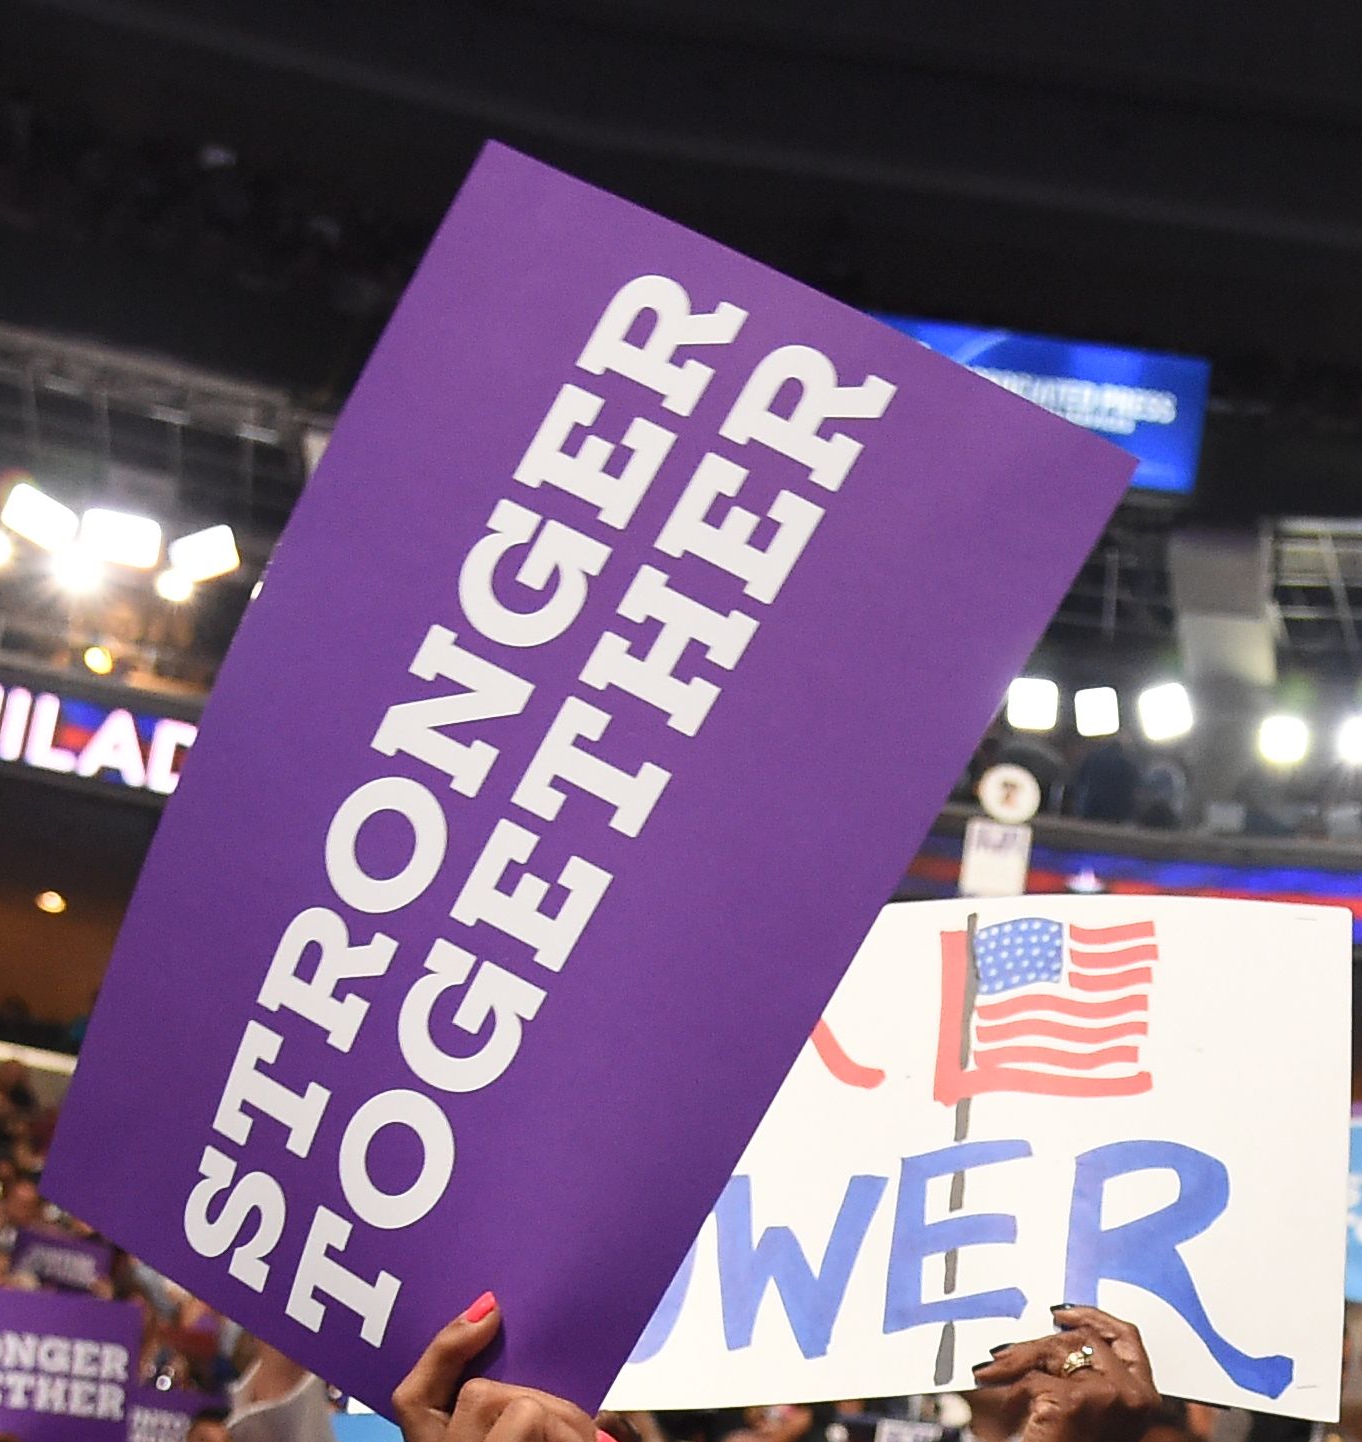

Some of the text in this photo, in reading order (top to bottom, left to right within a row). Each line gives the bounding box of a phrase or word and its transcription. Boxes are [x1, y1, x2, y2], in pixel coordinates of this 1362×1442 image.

[181, 273, 748, 1294] STRONGER
[285, 344, 899, 1348] TOGETHER
[627, 1138, 1295, 1400] WER
